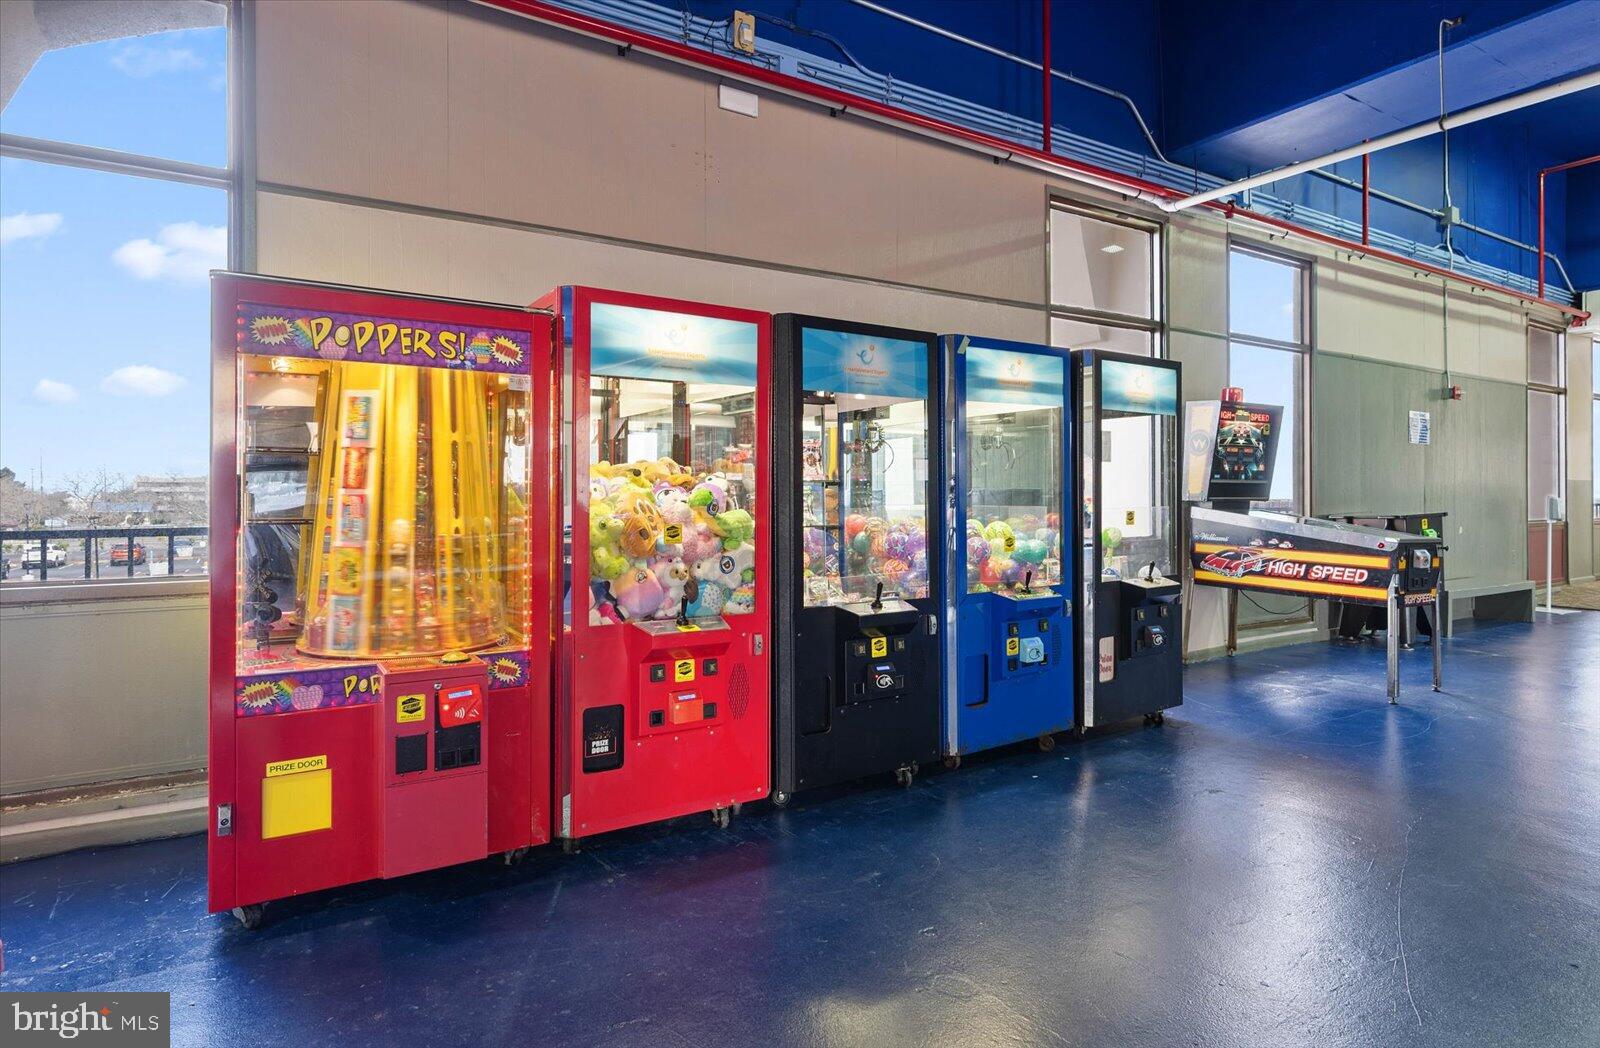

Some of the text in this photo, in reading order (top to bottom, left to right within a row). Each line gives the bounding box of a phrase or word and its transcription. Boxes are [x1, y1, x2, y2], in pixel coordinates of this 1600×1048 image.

[309, 316, 467, 361] POPPERS!
[1220, 411, 1271, 422] IGH SPEED
[1199, 532, 1229, 542] Williams
[1266, 561, 1369, 584] HIGH SPEED
[591, 739, 609, 748] PRIZE
[591, 745, 609, 754] DOOR
[269, 758, 324, 774] PRIZE DOOR
